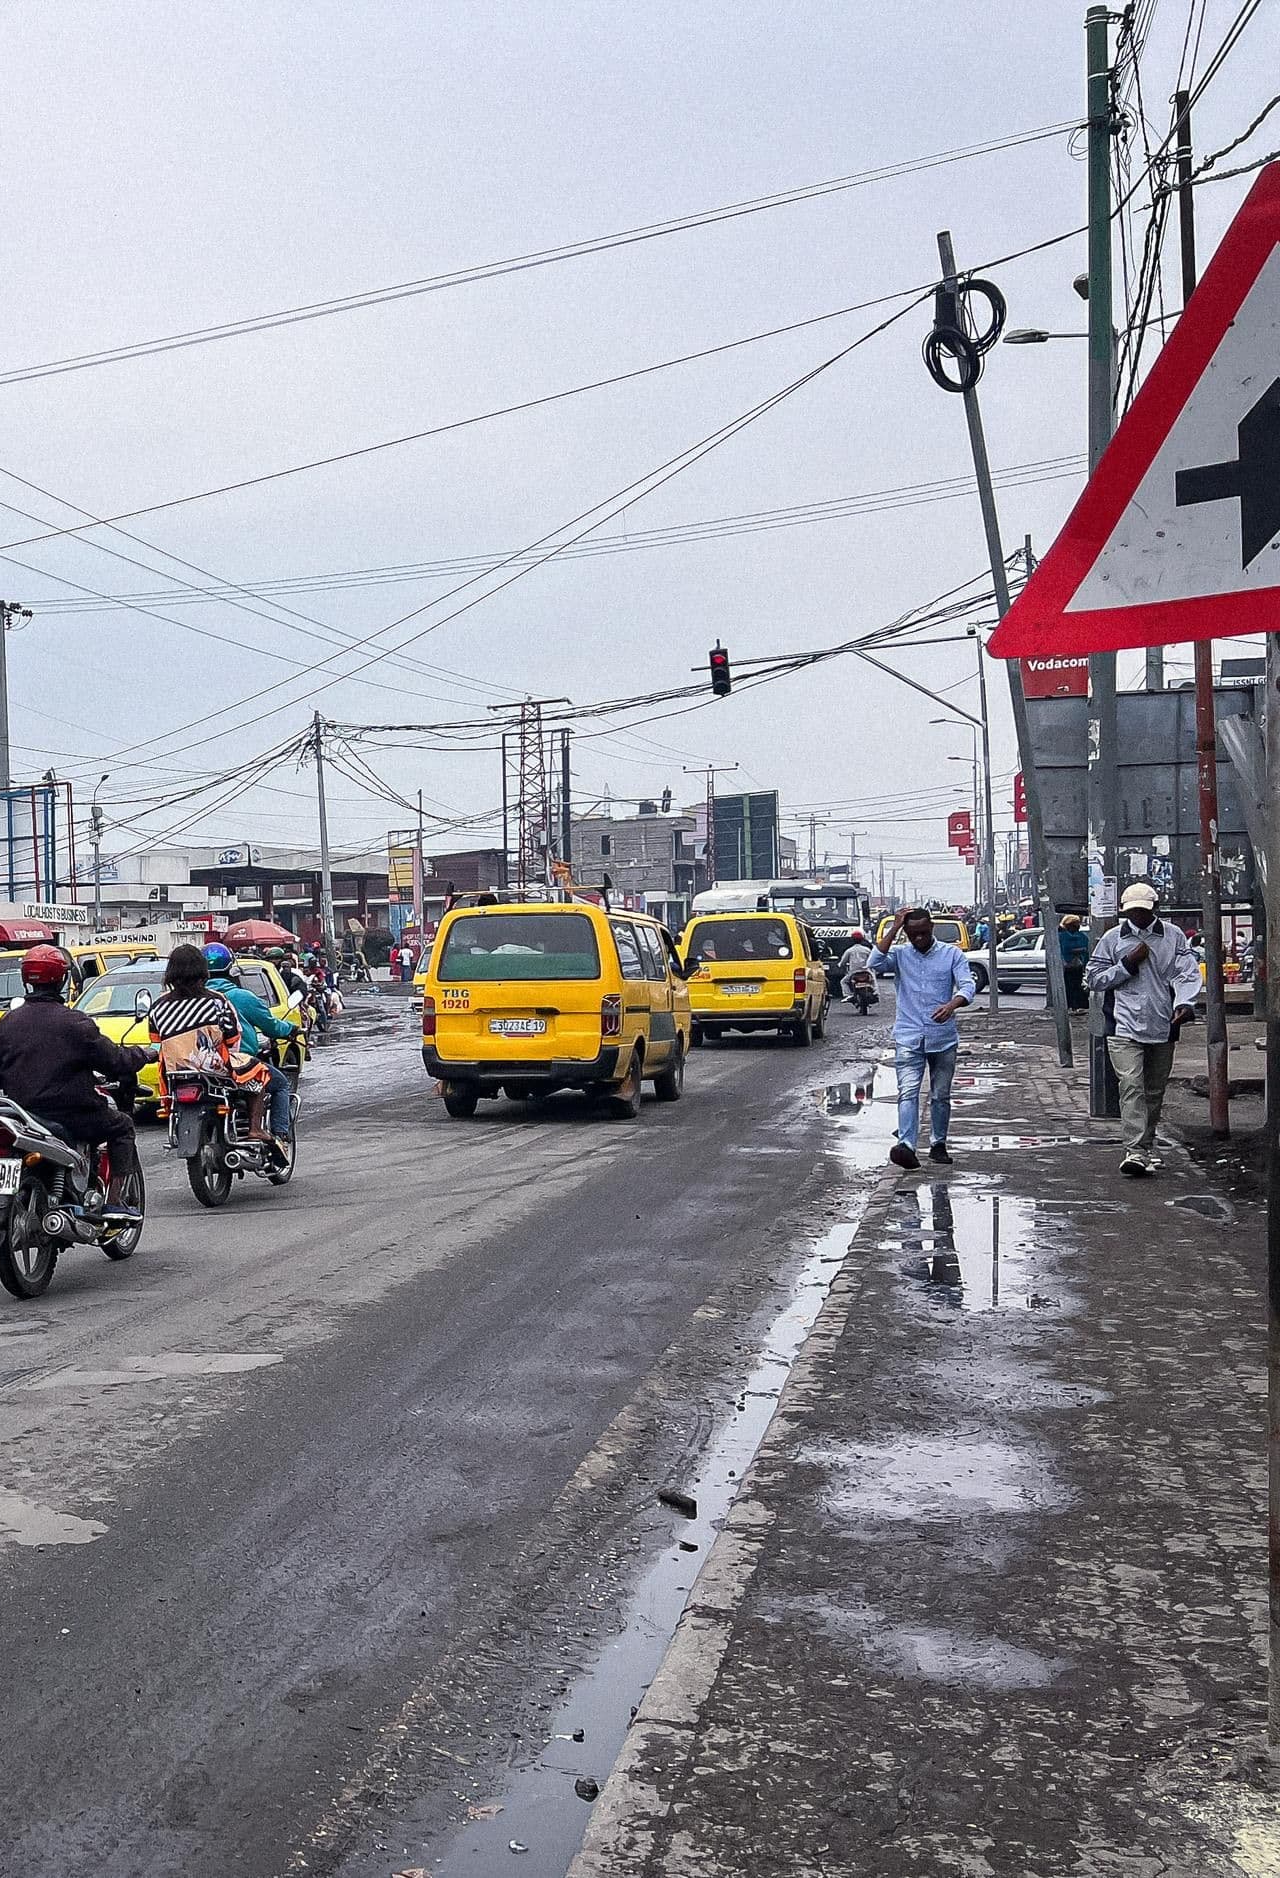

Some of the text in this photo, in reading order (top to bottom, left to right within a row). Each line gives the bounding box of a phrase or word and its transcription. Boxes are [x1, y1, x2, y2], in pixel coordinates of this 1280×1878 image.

[1027, 657, 1089, 672] Vodacom
[94, 937, 118, 945] SHOP
[441, 989, 470, 998] TBG
[441, 999, 470, 1009] 1920
